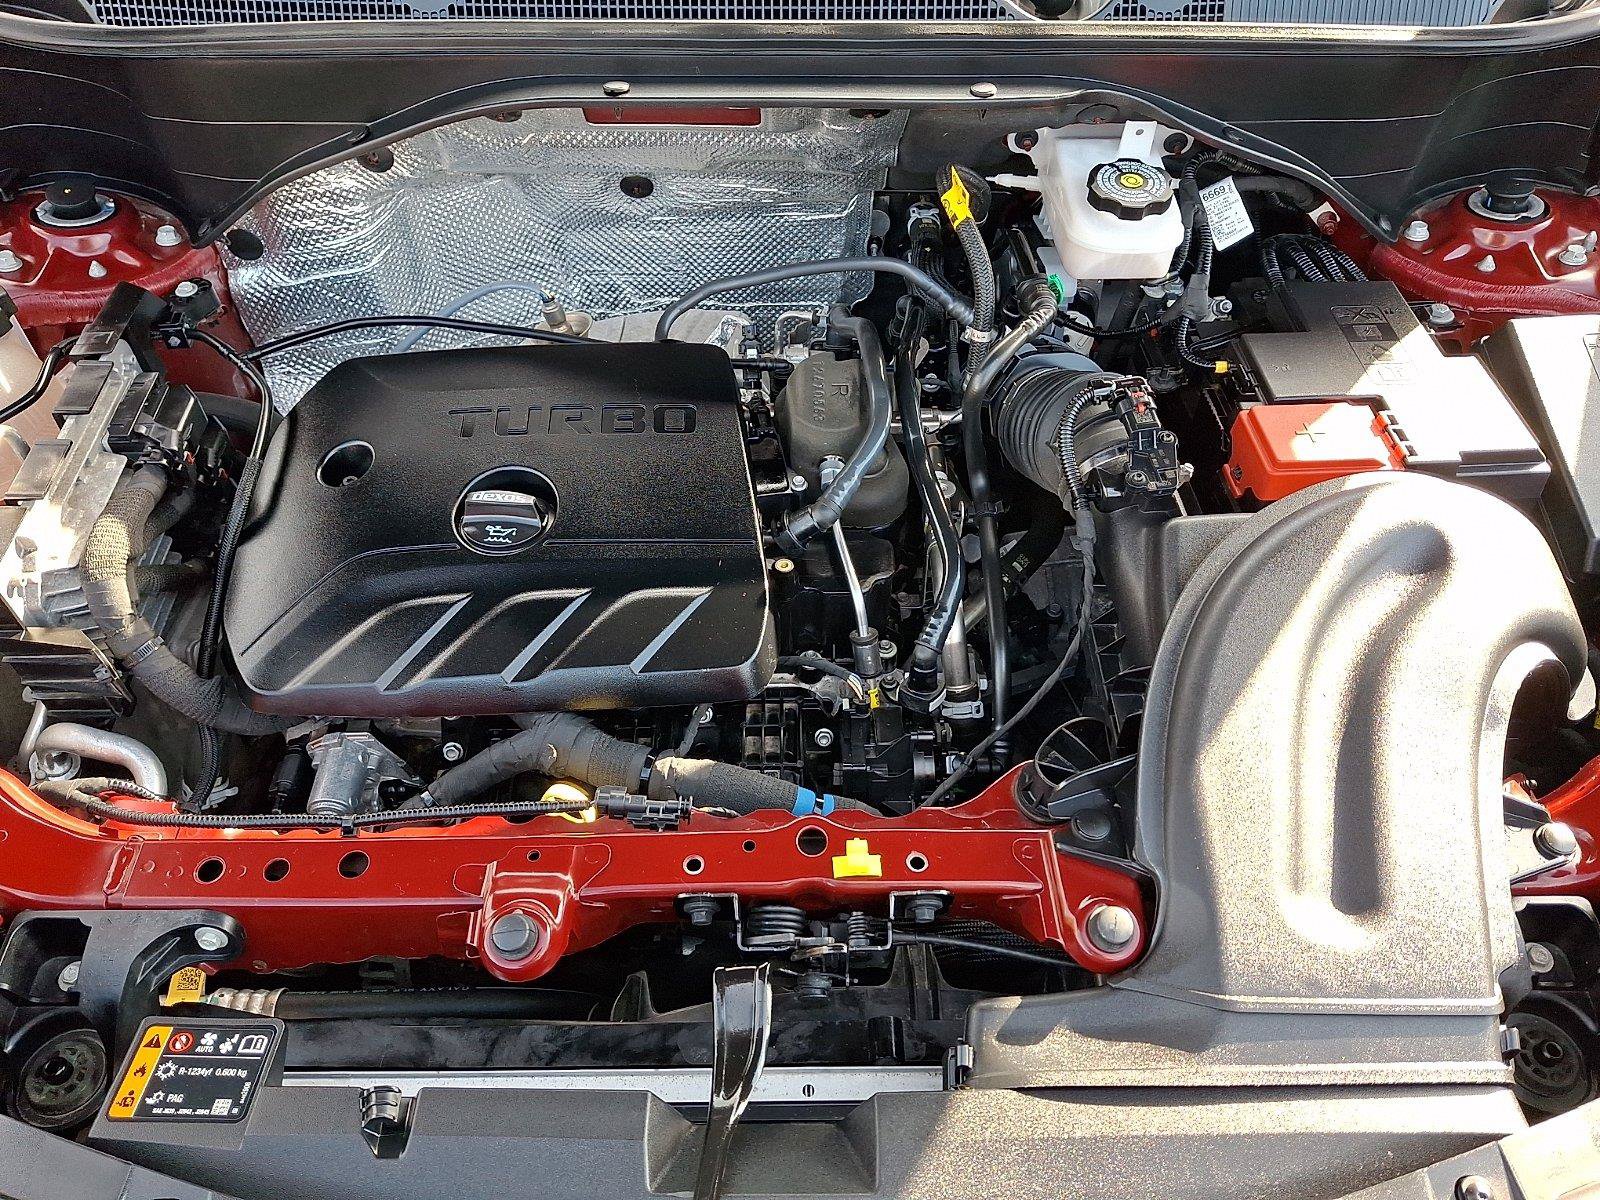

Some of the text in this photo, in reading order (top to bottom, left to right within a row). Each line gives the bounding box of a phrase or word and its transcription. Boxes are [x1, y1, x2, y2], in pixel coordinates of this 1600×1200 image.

[1202, 184, 1226, 203] 6669
[832, 383, 850, 397] R
[449, 404, 697, 438] TURBO
[178, 1067, 213, 1077] R-1234yf
[237, 1069, 248, 1078] kg
[166, 1094, 184, 1102] PAG
